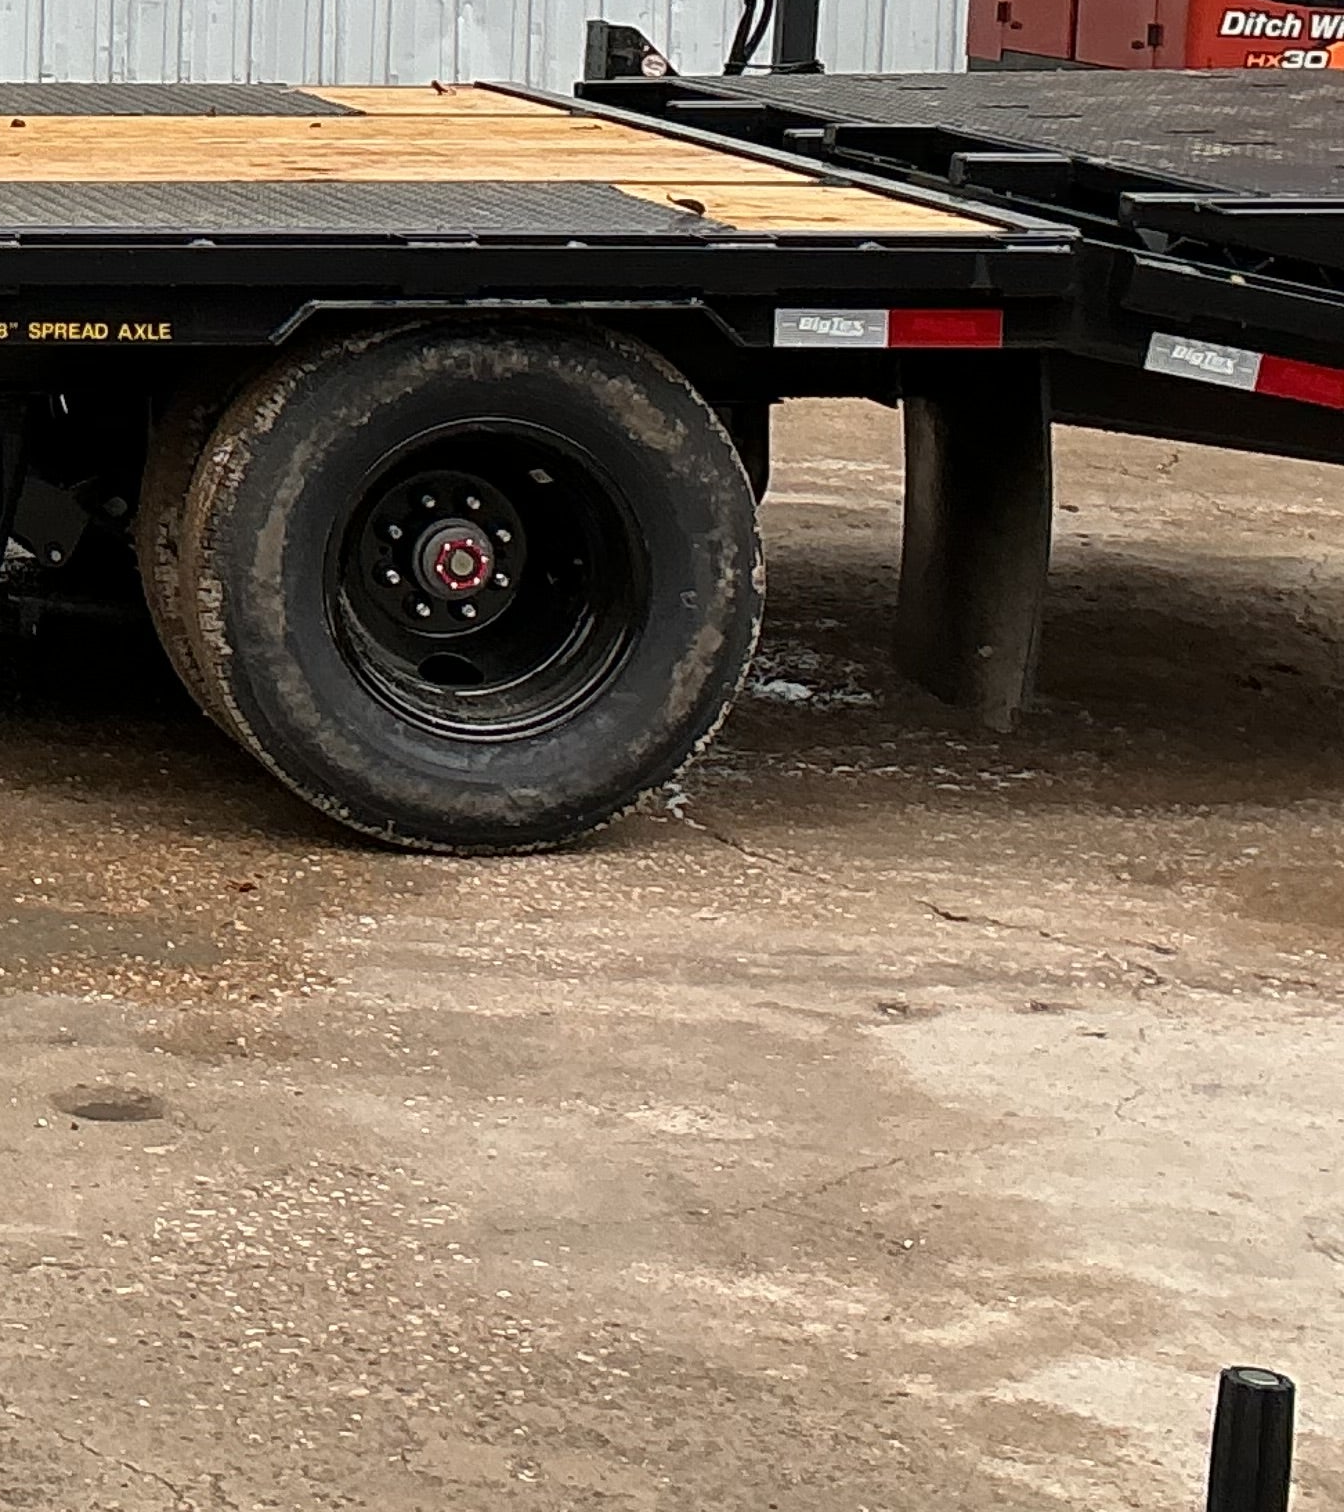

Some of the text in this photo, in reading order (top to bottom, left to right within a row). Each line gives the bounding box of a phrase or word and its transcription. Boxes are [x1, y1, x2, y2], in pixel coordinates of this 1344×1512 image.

[1220, 10, 1302, 38] Ditch
[1246, 49, 1330, 68] HX30
[28, 322, 109, 341] SPREAD
[117, 322, 173, 341] AXLE
